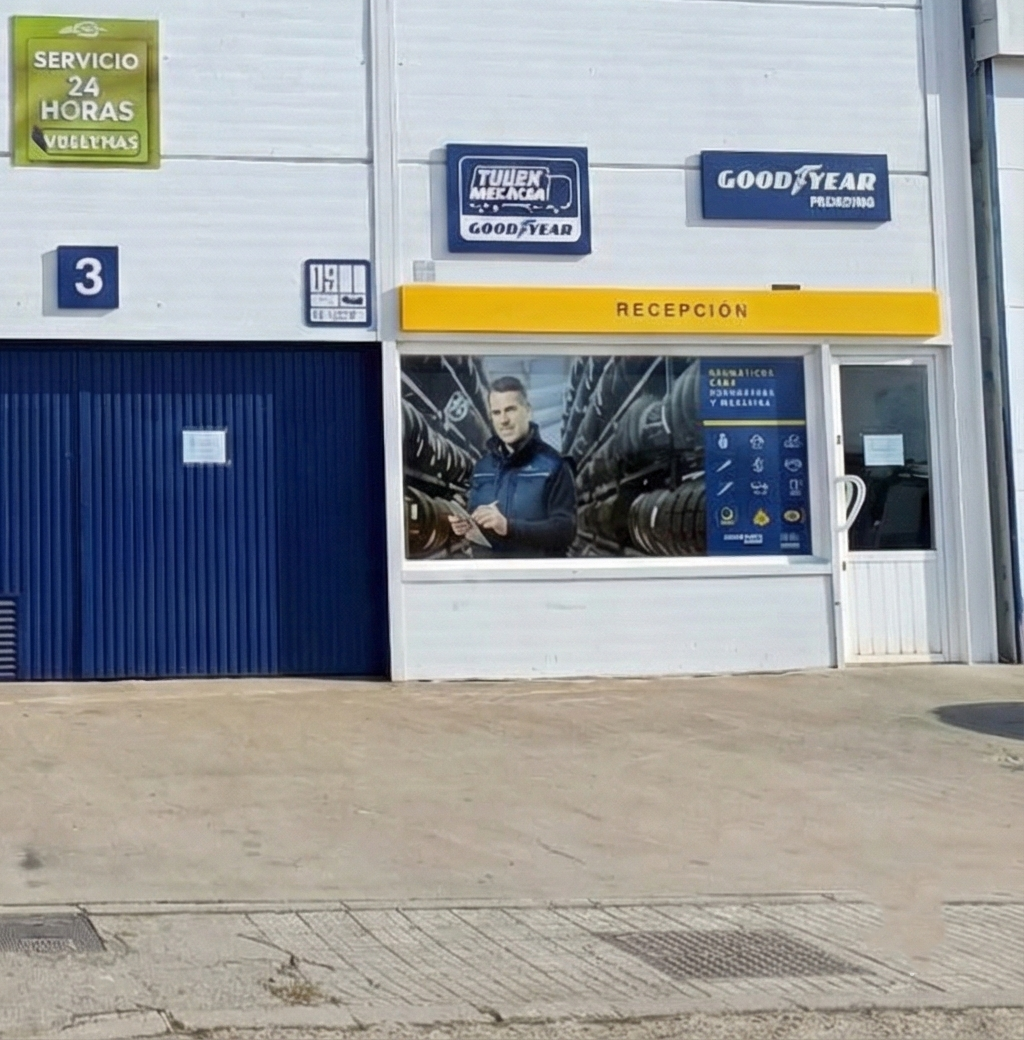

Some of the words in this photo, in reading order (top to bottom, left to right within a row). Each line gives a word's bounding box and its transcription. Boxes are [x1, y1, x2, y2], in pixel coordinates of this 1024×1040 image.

[33, 51, 139, 70] SERVICIO
[68, 75, 100, 97] 24
[41, 100, 135, 121] HORAS
[717, 164, 877, 196] GOODYEAR
[468, 219, 573, 239] GOODYEAR
[75, 257, 103, 296] 3
[616, 301, 748, 318] RECEPCIÓN
